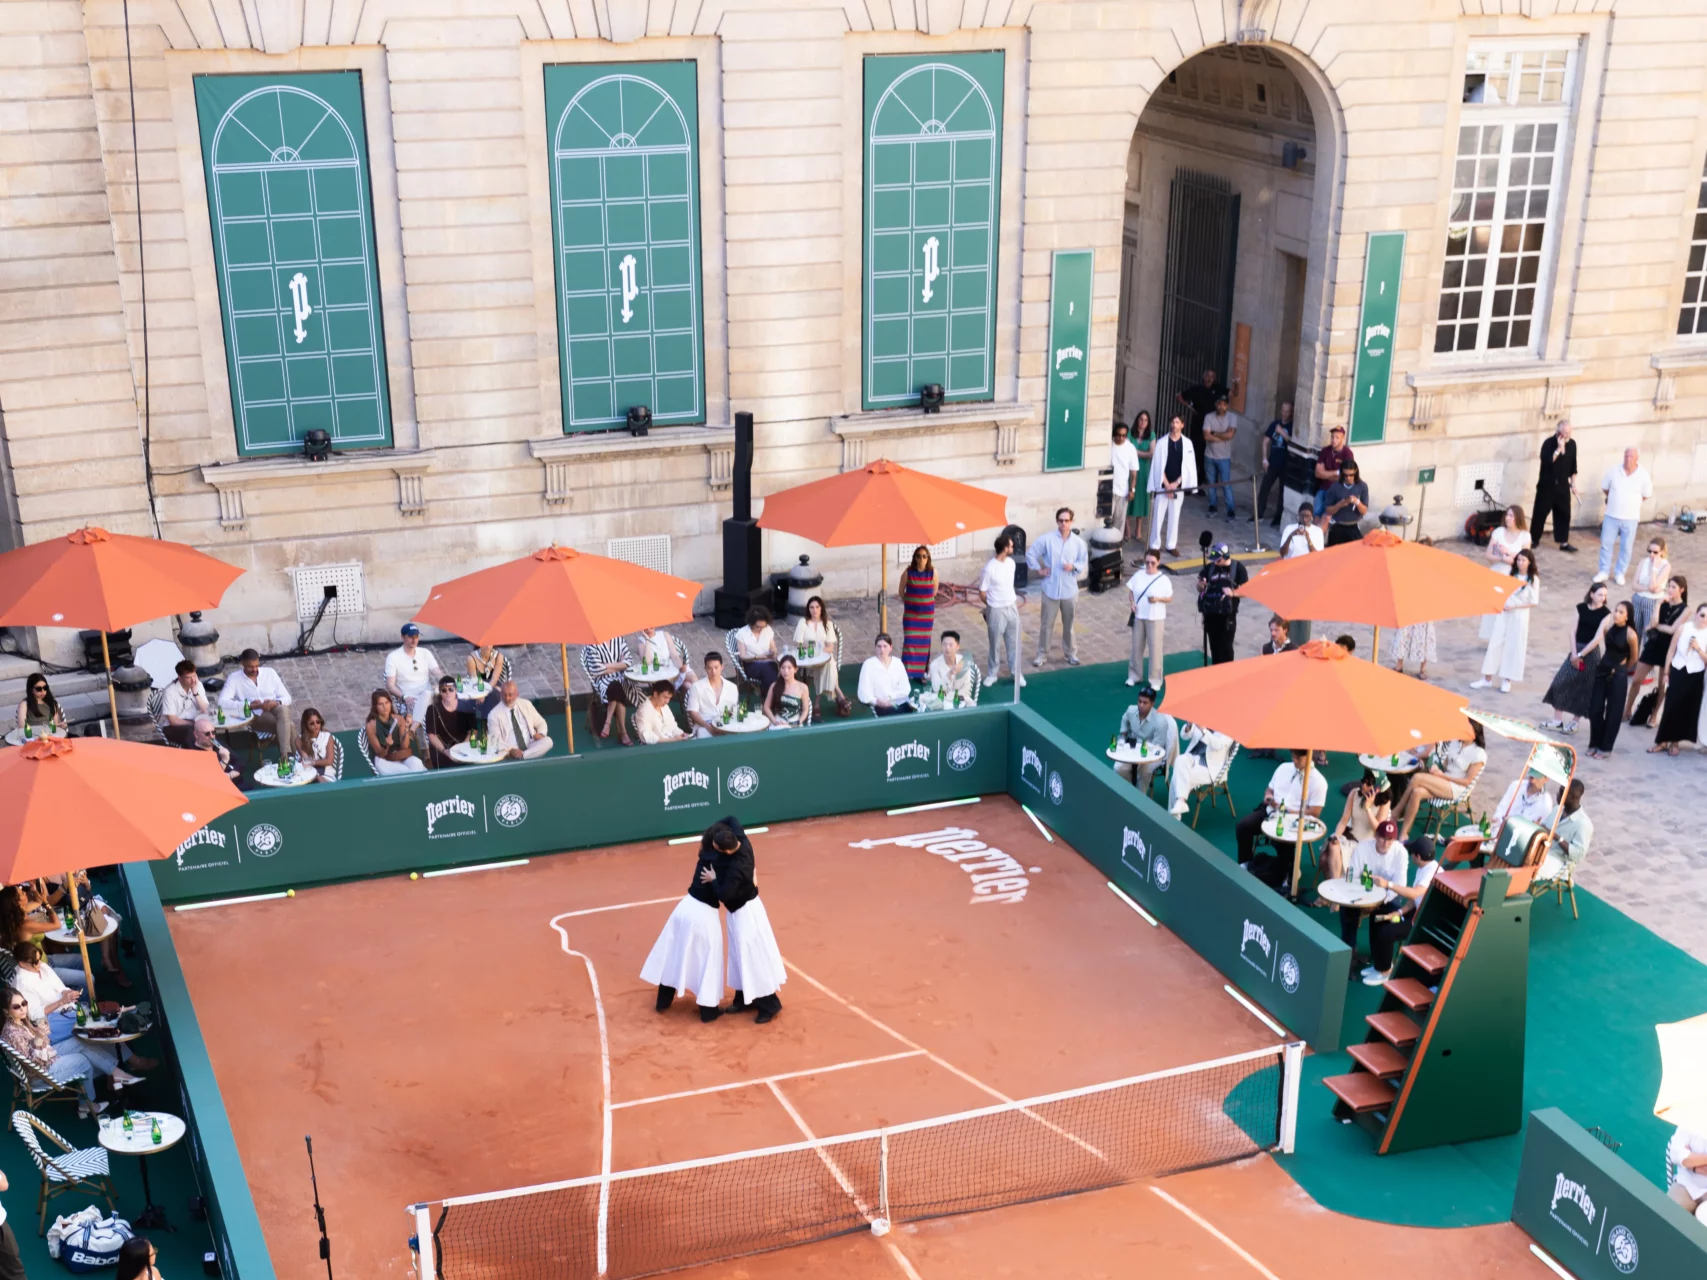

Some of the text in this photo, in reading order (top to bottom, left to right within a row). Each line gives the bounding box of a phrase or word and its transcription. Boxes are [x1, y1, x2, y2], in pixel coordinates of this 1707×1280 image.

[886, 739, 930, 777] perrier
[1021, 746, 1042, 777] perrier
[663, 767, 709, 806] perrier
[426, 795, 475, 834] perrier
[1122, 826, 1146, 861] perrier
[848, 826, 1042, 905] perrier
[1241, 919, 1271, 958] perrier
[1551, 1172, 1596, 1225] perrier
[71, 1251, 120, 1265] Babol
